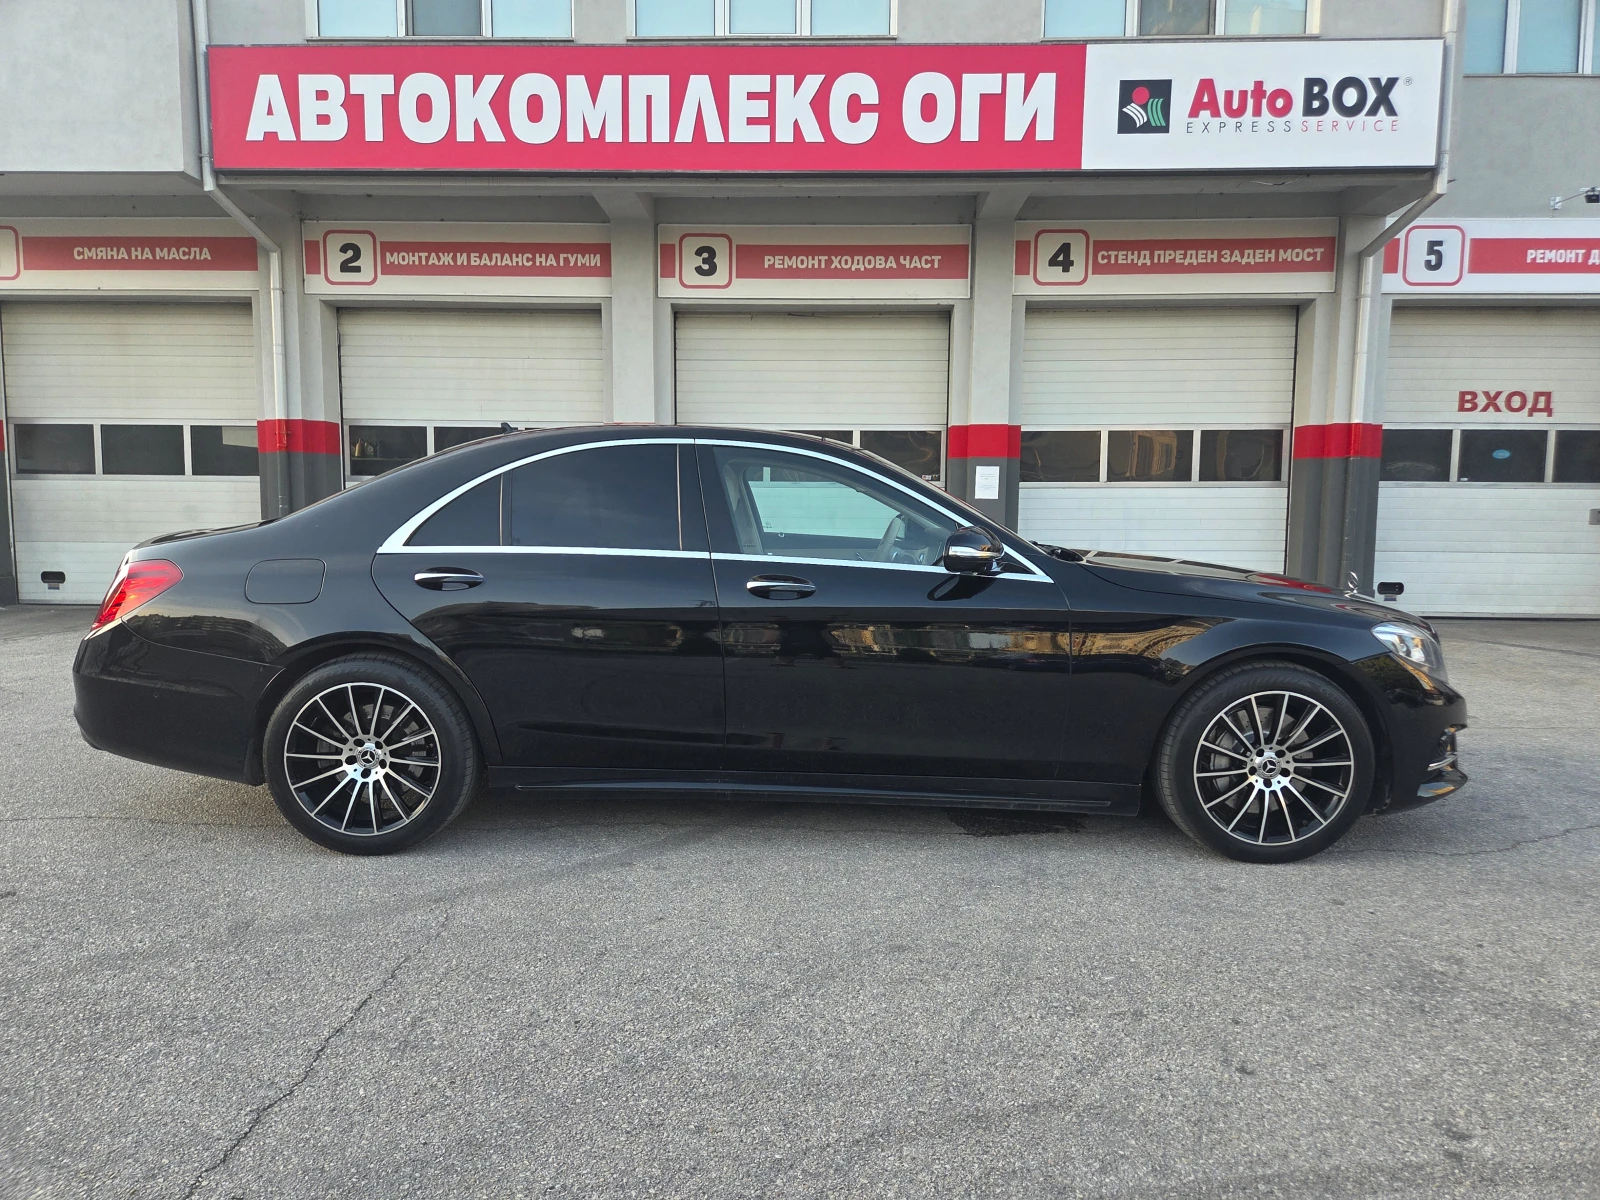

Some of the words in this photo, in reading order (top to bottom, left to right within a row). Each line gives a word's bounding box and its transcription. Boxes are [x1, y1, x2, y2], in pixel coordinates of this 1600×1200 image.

[245, 71, 880, 145] АВТОКОМПЛЕКС
[902, 71, 1057, 143] ОГИ
[1187, 78, 1294, 119] Auto
[1302, 76, 1400, 118] BOX
[1186, 120, 1292, 134] EXPRESS
[1301, 119, 1400, 132] SERVICE
[73, 246, 129, 260] СМЯНА
[131, 246, 153, 260] НА
[155, 246, 212, 260] МАСЛА
[339, 242, 362, 273] 2
[385, 251, 453, 266] МОНТАЖ
[456, 252, 468, 266] И
[470, 252, 533, 266] БАЛАНС
[535, 253, 557, 267] НА
[559, 253, 601, 267] ГУМИ
[694, 245, 718, 277] 3
[764, 255, 829, 269] РЕМОНТ
[830, 255, 897, 271] ХОДОВА
[899, 255, 942, 269] ЧАСТ
[1048, 242, 1075, 273] 4
[1097, 250, 1151, 266] СТЕНД
[1153, 249, 1218, 265] ПРЕДЕН
[1220, 248, 1276, 265] ЗАДЕН
[1278, 247, 1325, 262] МОСТ
[1424, 240, 1444, 272] 5
[1526, 249, 1586, 263] РЕМОНТ
[1456, 390, 1554, 418] ВХОД
